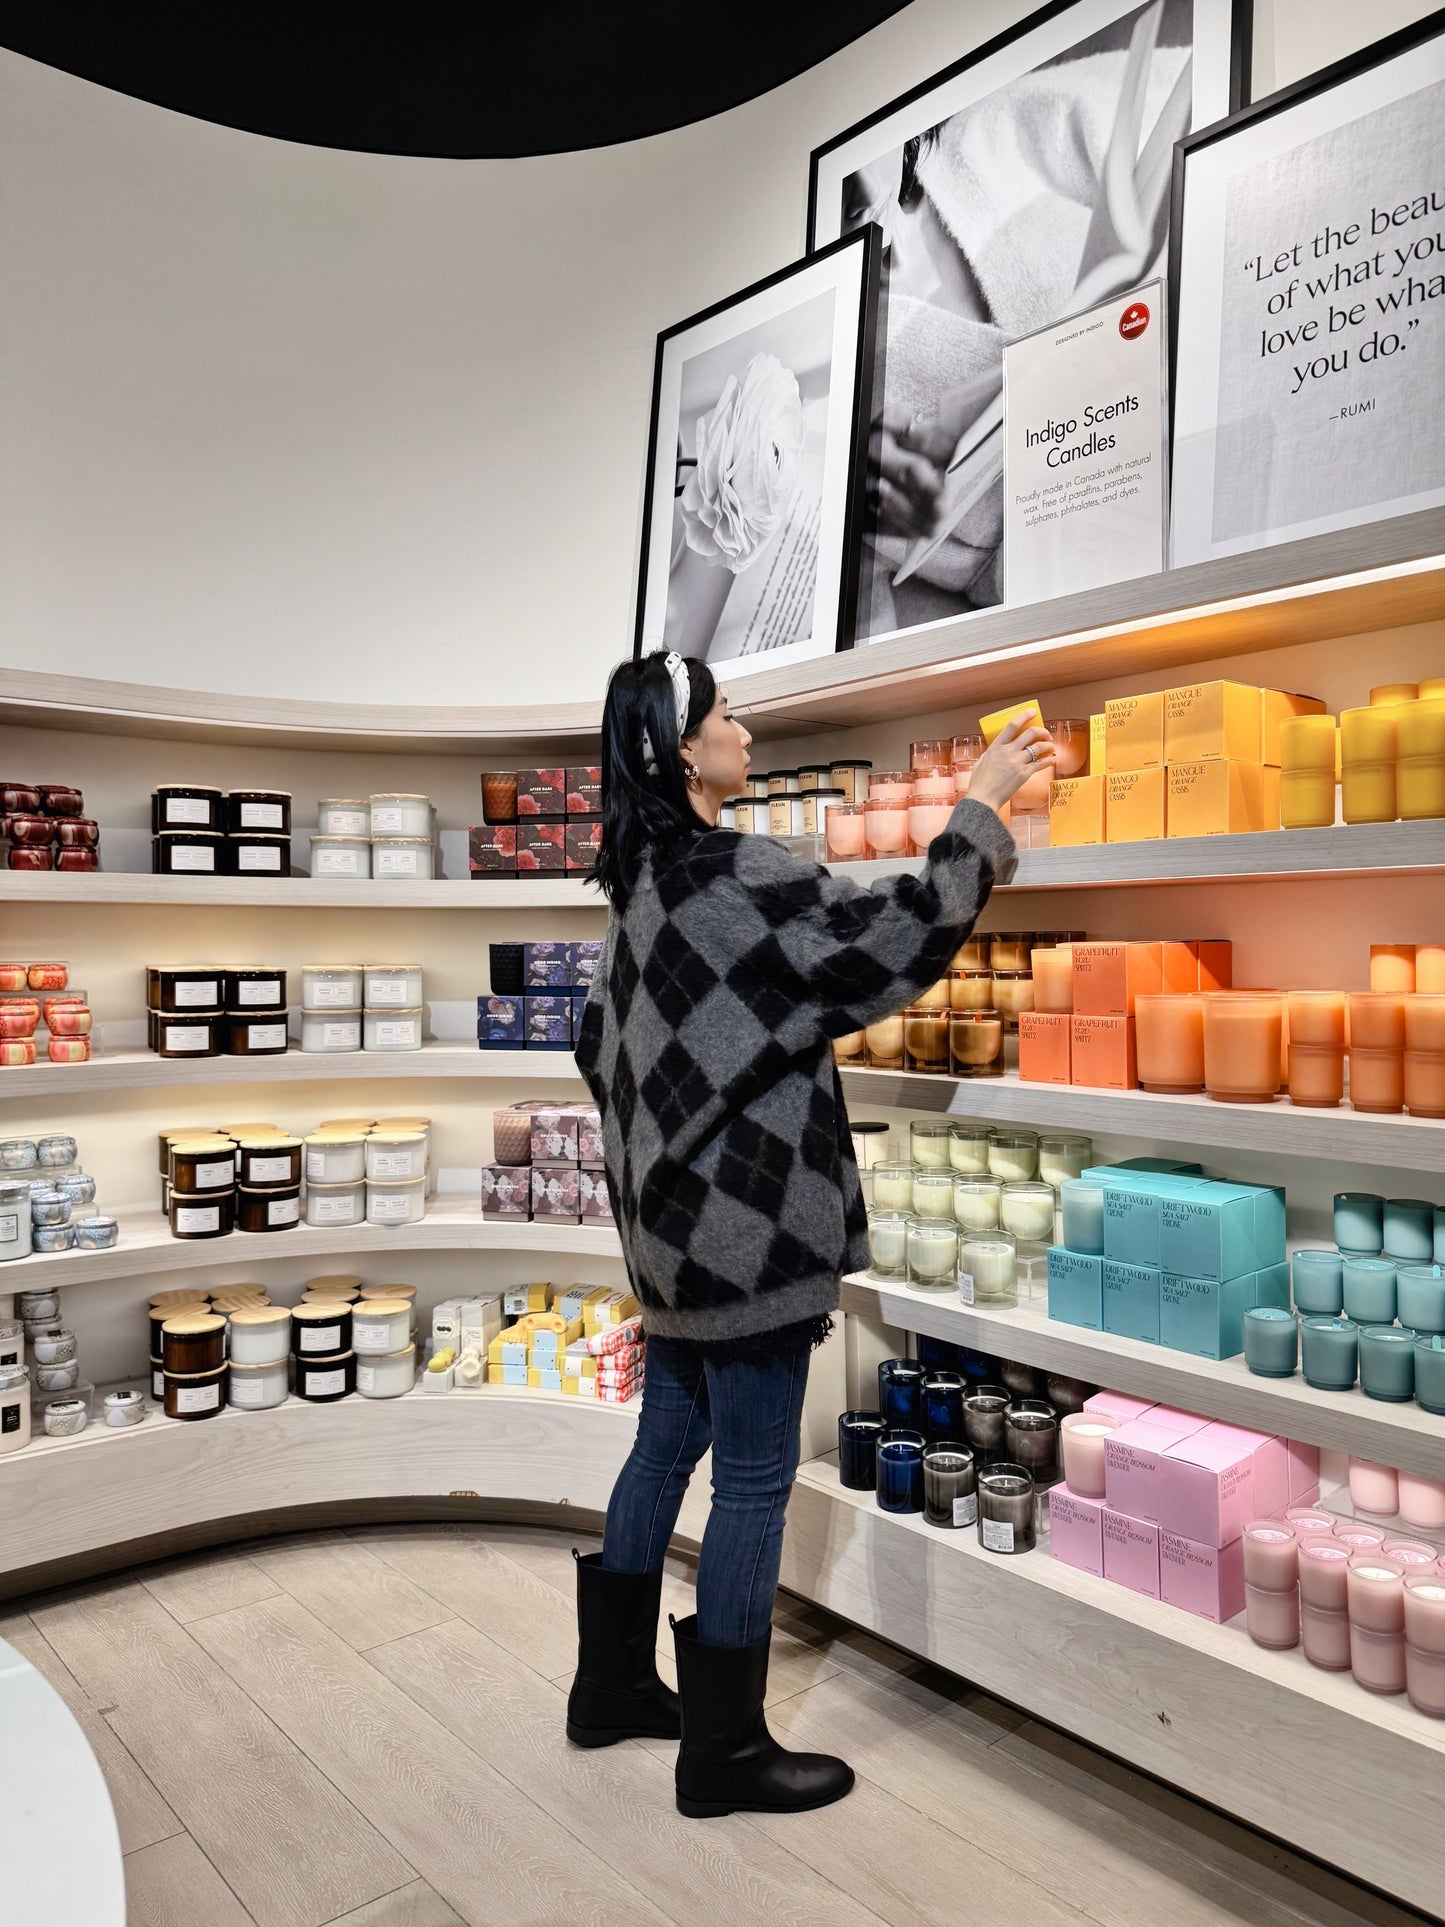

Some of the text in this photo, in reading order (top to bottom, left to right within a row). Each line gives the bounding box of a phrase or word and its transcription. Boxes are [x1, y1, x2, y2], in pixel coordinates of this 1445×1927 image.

[1244, 242, 1303, 282] “Let
[1311, 222, 1361, 259] the
[1267, 279, 1299, 315] of
[1305, 250, 1385, 299] what
[1122, 316, 1147, 332] Canadian
[1260, 320, 1319, 358] love
[1329, 303, 1366, 333] be
[1055, 331, 1078, 346] DESIGNED
[1085, 321, 1104, 334] INDIGO
[1291, 318, 1420, 394] you do.”
[1026, 395, 1139, 448] Indigo Scents
[1046, 432, 1116, 468] Candles
[1015, 451, 1152, 505] Proudly made in Canada with natural
[1023, 471, 1143, 515] wax. Free of paraffins, parabens,
[1025, 486, 1141, 527] sulphates, phthalates, and dyes.
[1168, 688, 1202, 701] MANGUE
[1108, 700, 1138, 712] MANGO
[1168, 700, 1193, 710] ORANGE
[1108, 710, 1133, 720] ORANGE
[1171, 765, 1206, 778] MANGUE
[1052, 781, 1079, 791] MANGO
[1109, 774, 1139, 786] MANGO
[1171, 776, 1198, 786] ORANGE
[1052, 790, 1074, 800] ORANGE
[1109, 784, 1134, 793] ORANGE
[1075, 948, 1120, 956] GRAPEFRUIT
[1075, 964, 1093, 973] SPRITZ
[1021, 1016, 1062, 1026] GRAPEFRUIT
[1074, 1020, 1119, 1029] GRAPEFRUIT
[1021, 1031, 1037, 1040] SPRITZ
[1074, 1034, 1091, 1044] SPRITZ
[1106, 1191, 1153, 1207] DRIFTWOOD
[1106, 1201, 1133, 1211] SEA SALT
[1162, 1200, 1212, 1217] DRIFTWOOD
[1162, 1211, 1192, 1221] SEA SALT
[1049, 1253, 1092, 1270] DRIFTWOOD
[1049, 1262, 1075, 1273] SEA SALT
[1105, 1264, 1151, 1282] DRIFTWOOD
[1105, 1274, 1132, 1285] SEA SALT
[1162, 1276, 1210, 1294] DRIFTWOOD
[1162, 1286, 1191, 1297] SEA SALT
[1106, 1442, 1135, 1458] JASMINE
[1107, 1451, 1131, 1464] ORANGE
[1220, 1466, 1240, 1483] JASMINE
[1051, 1494, 1078, 1511] JASMINE
[1051, 1504, 1071, 1515] ORANGE
[1105, 1513, 1133, 1531] JASMINE
[1105, 1523, 1128, 1536] ORANGE
[1162, 1533, 1191, 1552] JASMINE
[1162, 1543, 1186, 1556] ORANGE
